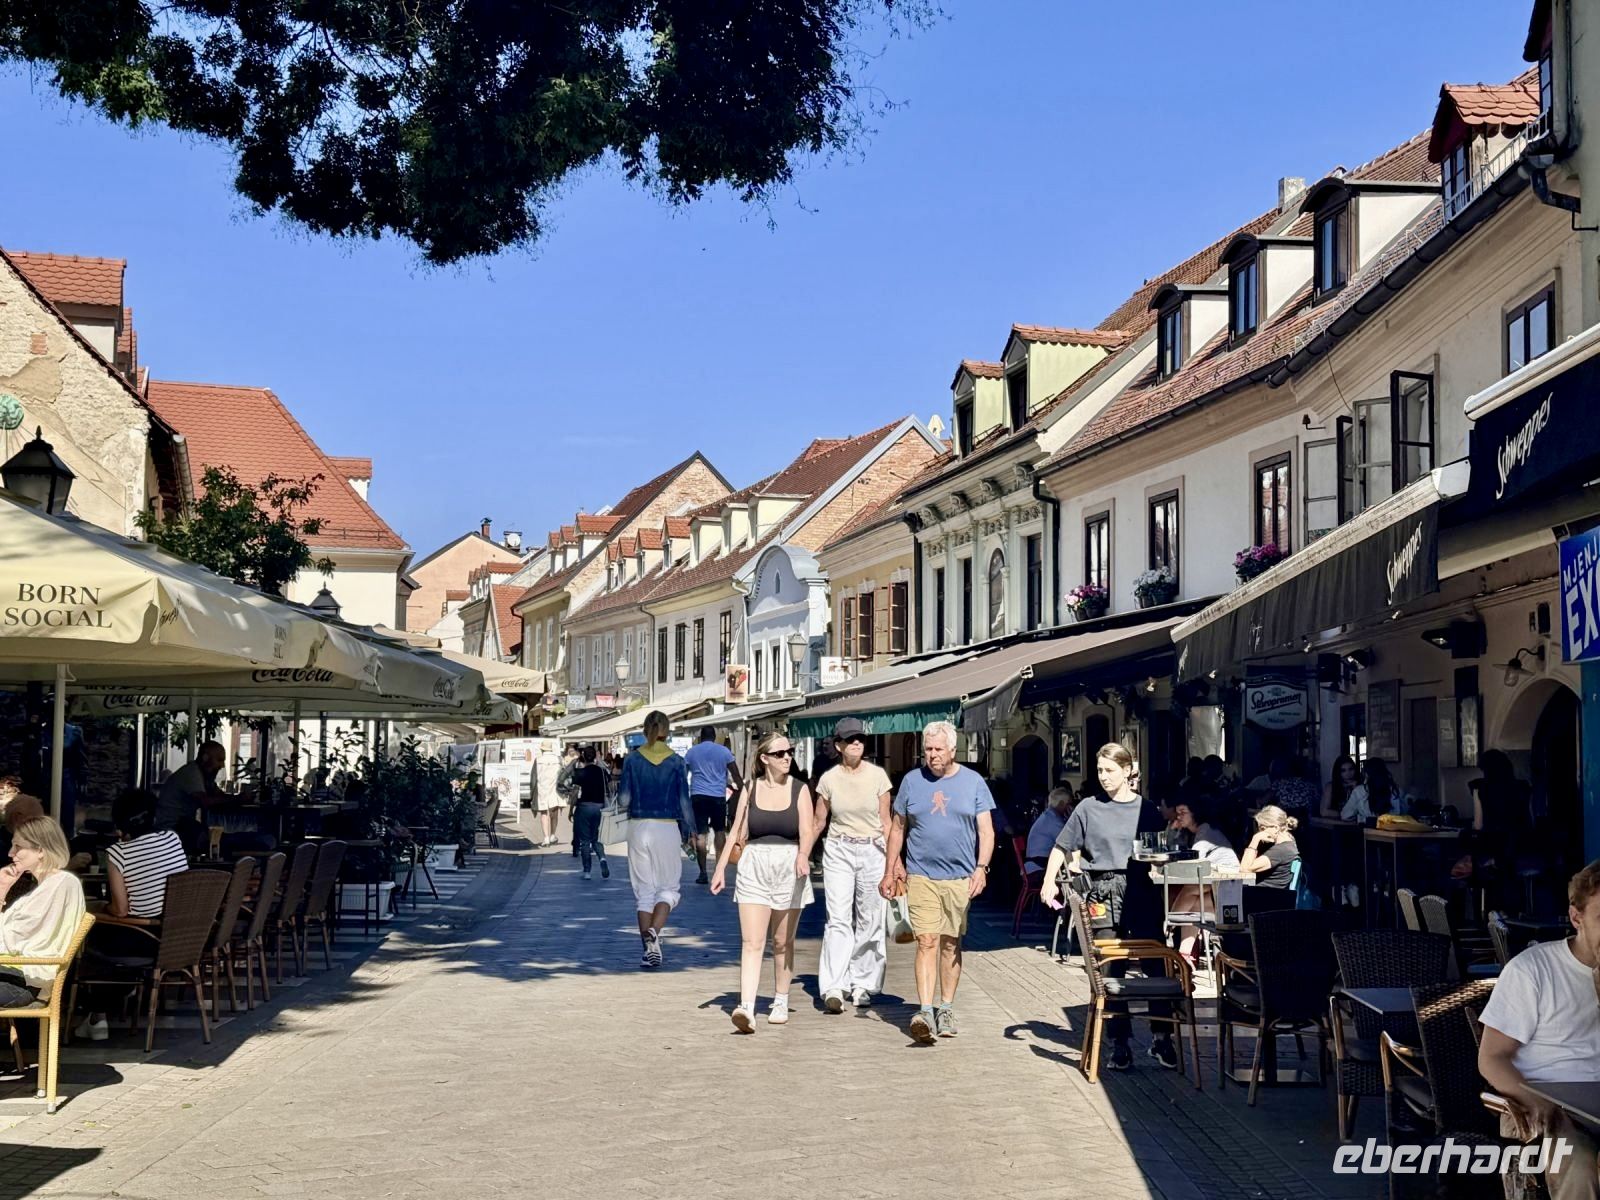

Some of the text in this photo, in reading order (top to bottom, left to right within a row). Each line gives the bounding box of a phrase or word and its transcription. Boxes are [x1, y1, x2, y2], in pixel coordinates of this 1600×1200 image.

[1496, 391, 1554, 500] Schweppes
[1387, 521, 1422, 605] Schweppes
[4, 607, 113, 628] SOCIAL
[16, 583, 101, 605] BORN
